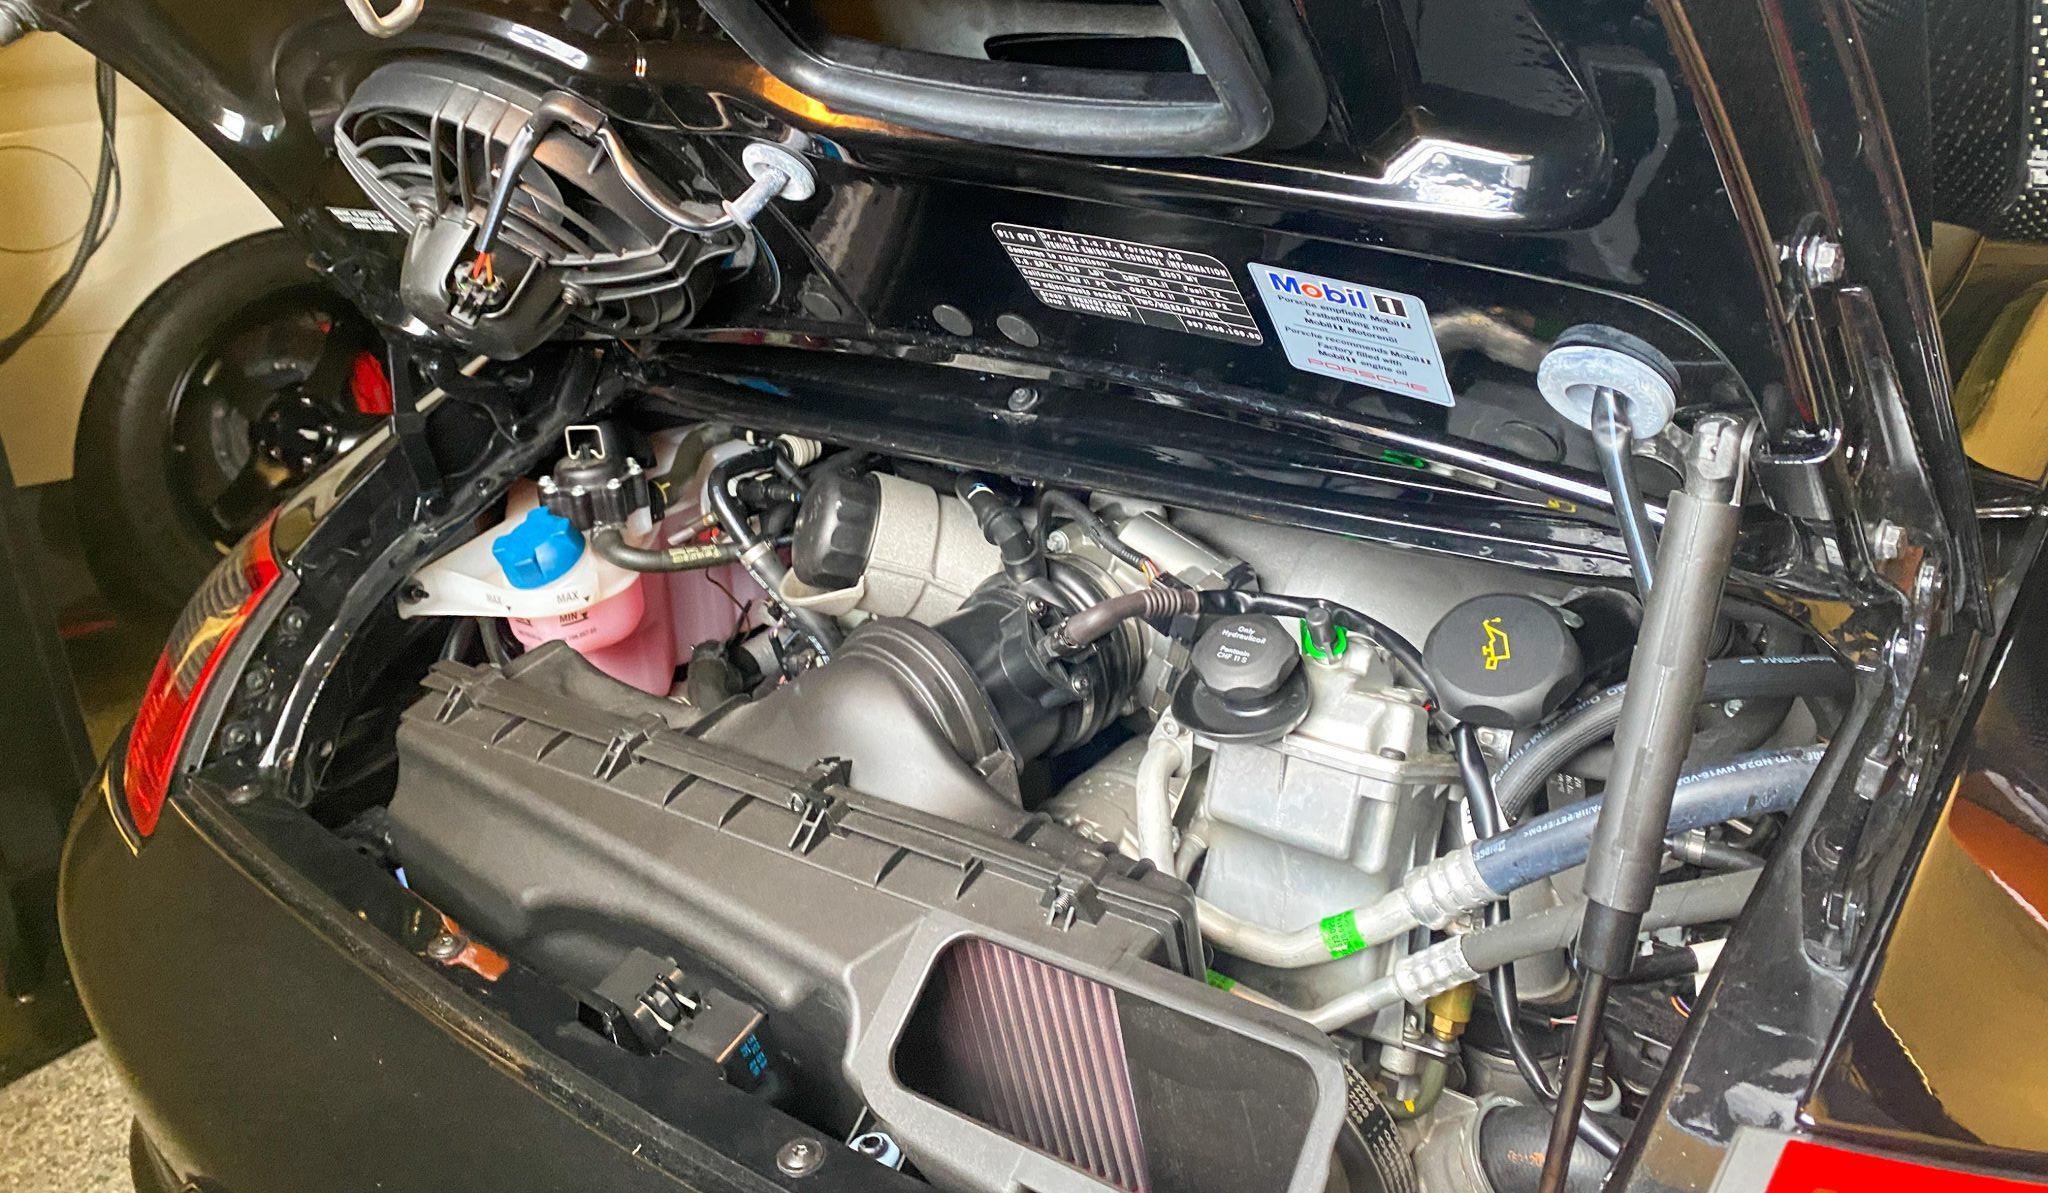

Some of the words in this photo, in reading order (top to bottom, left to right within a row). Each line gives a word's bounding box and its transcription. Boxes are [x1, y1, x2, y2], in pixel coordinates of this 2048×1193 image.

[996, 229, 1014, 238] 911
[1017, 233, 1036, 242] GT3
[1058, 235, 1079, 244] Ing.
[1121, 245, 1163, 257] Porsche
[1007, 246, 1045, 257] Conforms
[1159, 271, 1182, 279] 2007
[1045, 240, 1079, 251] VEHICLE
[1081, 246, 1122, 259] EMISSION
[1125, 254, 1164, 265] CONTROL
[1166, 260, 1227, 276] INFORMATION
[1268, 273, 1368, 309] Mobil
[1278, 295, 1317, 308] Porsche
[1320, 304, 1366, 319] empfiehlt
[1305, 310, 1369, 328] Erstbefüllung
[1372, 324, 1388, 332] mit
[1285, 327, 1323, 339] Porsche
[1326, 336, 1387, 354] recommends
[1348, 327, 1397, 343] Motorenöl
[1317, 342, 1353, 355] Factory
[1356, 351, 1379, 360] filled
[1307, 358, 1428, 392] PORSCHE
[1360, 361, 1392, 372] engine
[556, 591, 579, 604] MAX
[559, 611, 578, 623] MIN
[1238, 626, 1256, 636] Only
[1216, 651, 1233, 660] CHF
[1241, 656, 1248, 664] S
[1354, 1084, 1375, 1112] 2260
